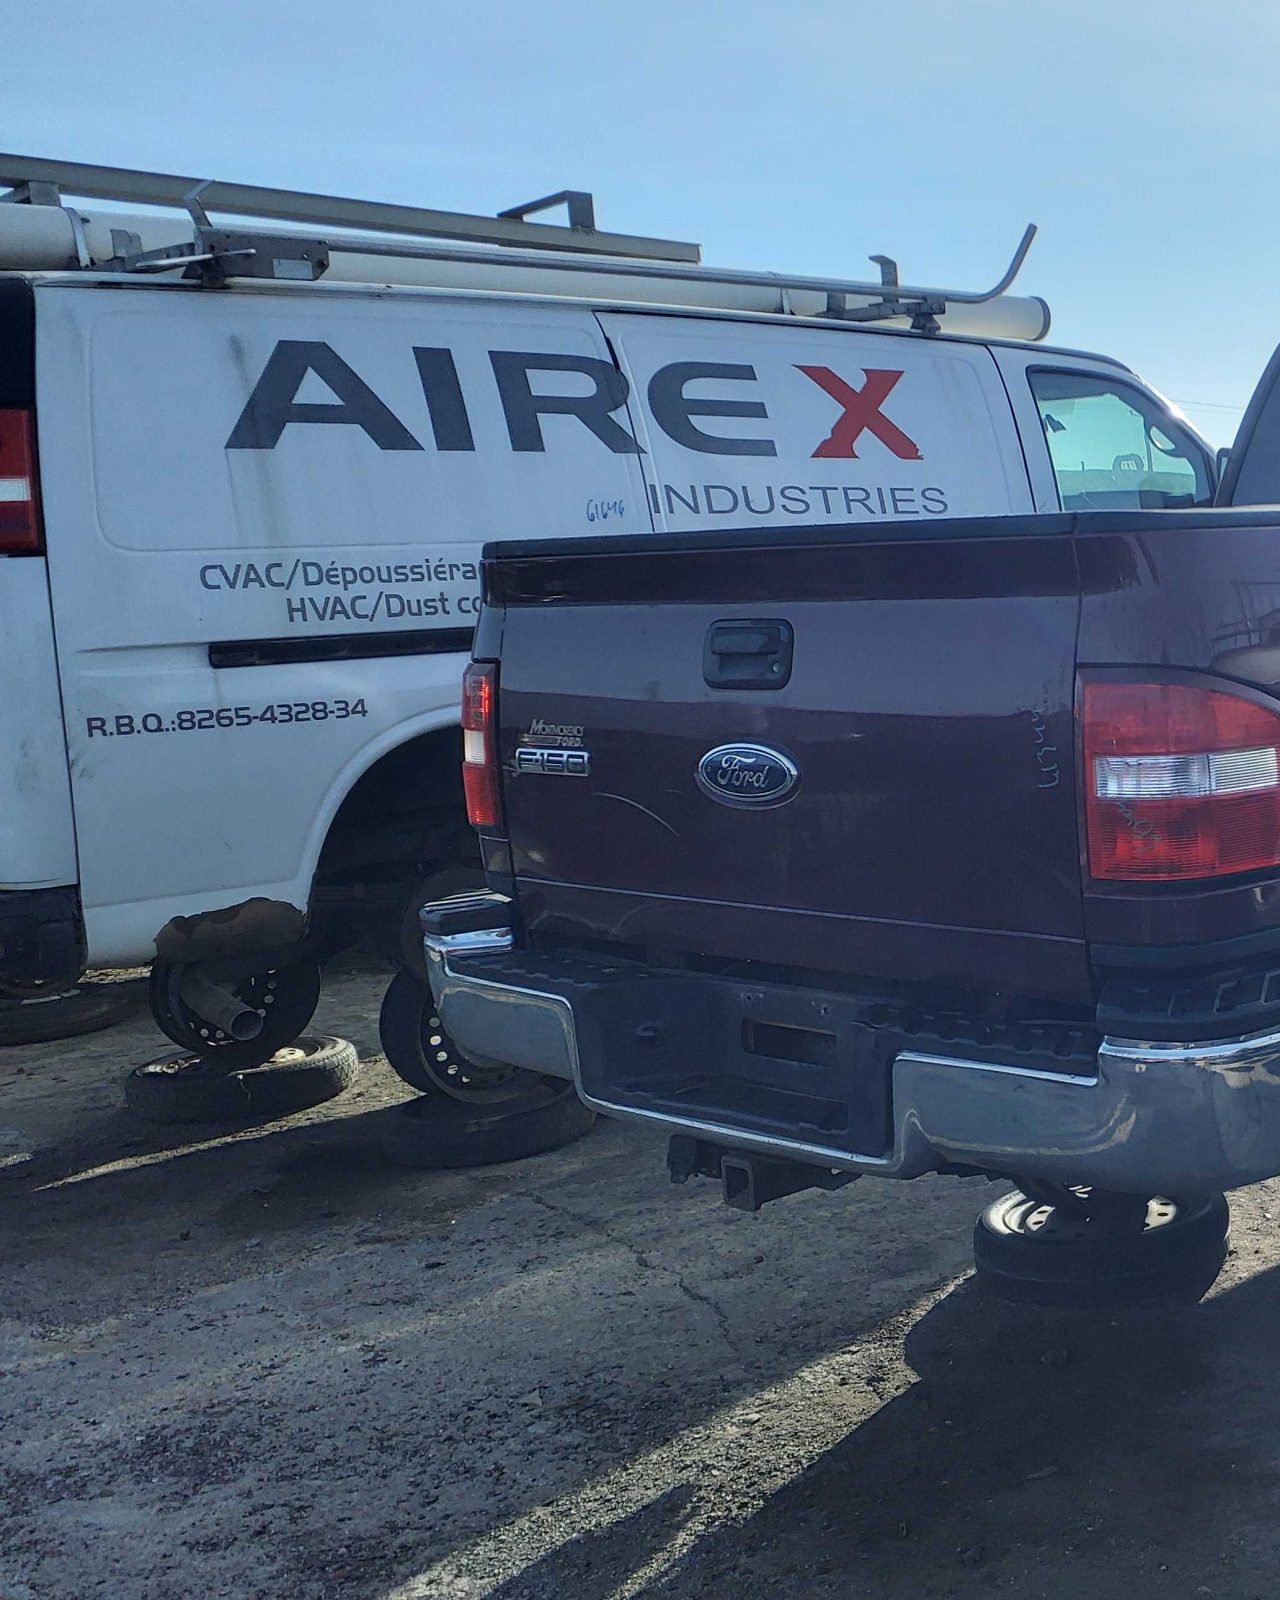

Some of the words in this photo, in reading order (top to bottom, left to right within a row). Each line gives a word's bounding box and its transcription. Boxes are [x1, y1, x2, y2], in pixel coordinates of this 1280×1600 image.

[224, 339, 924, 460] AIREX
[650, 484, 948, 515] INDUSTRIES
[199, 558, 480, 591] CVAC/Dépoussiéra
[286, 591, 450, 622] HVAC/Dust
[86, 698, 368, 738] R.B.Q.:8265-4328-34
[716, 754, 770, 790] Ford
